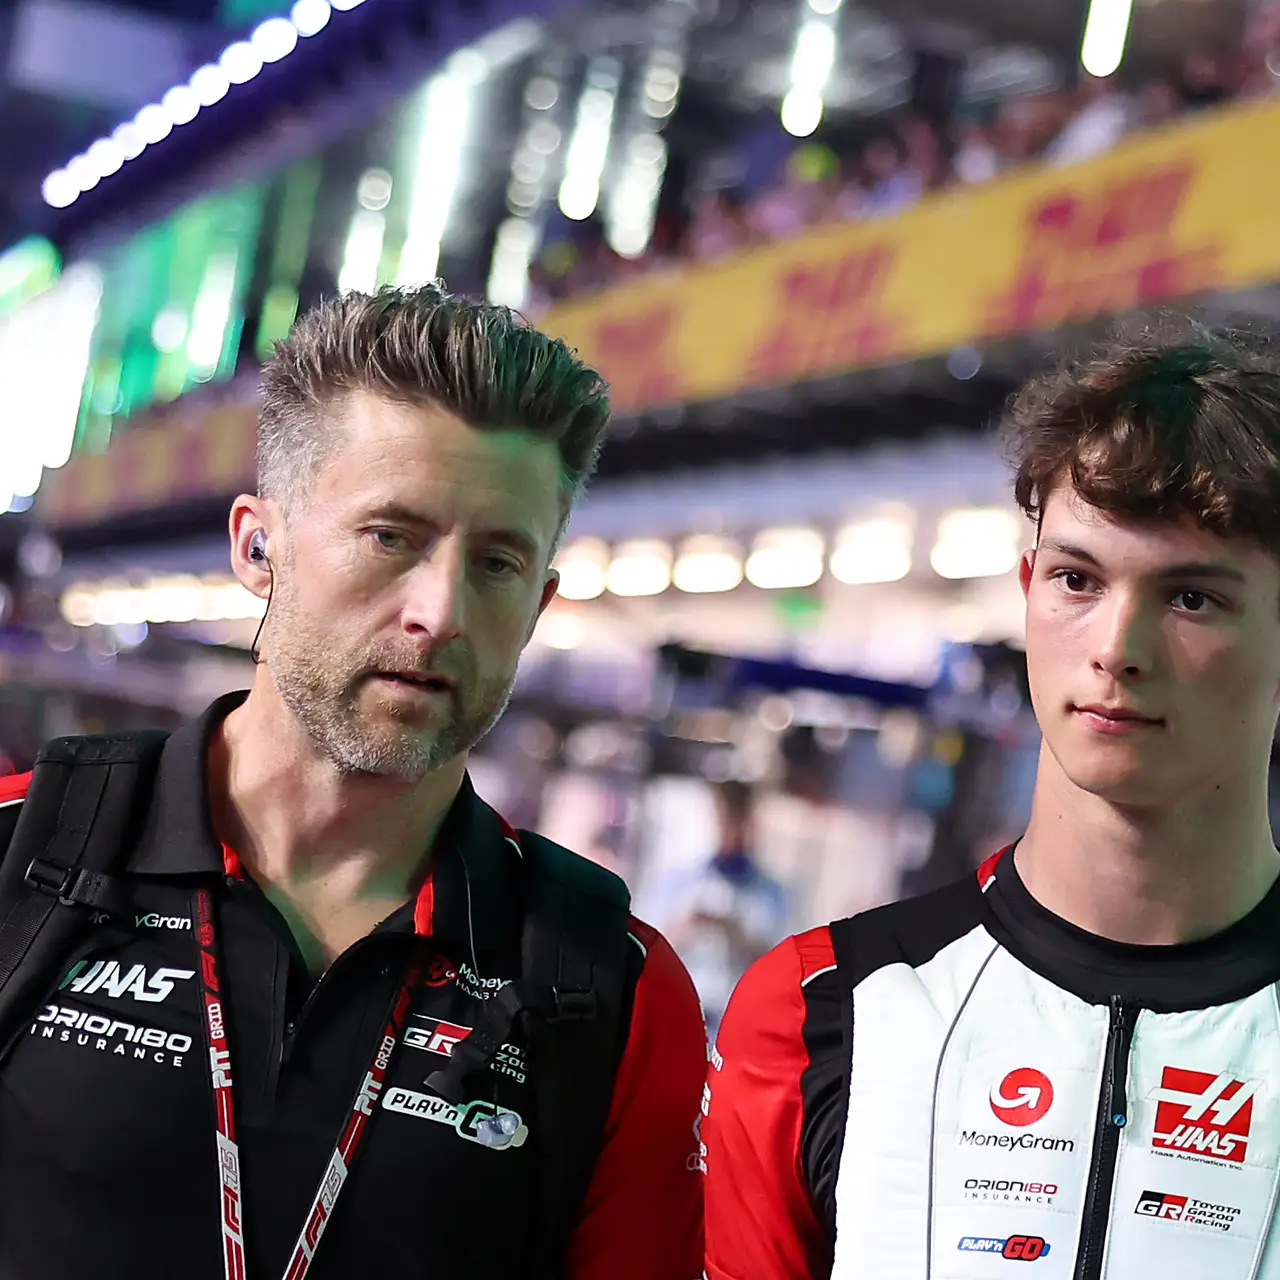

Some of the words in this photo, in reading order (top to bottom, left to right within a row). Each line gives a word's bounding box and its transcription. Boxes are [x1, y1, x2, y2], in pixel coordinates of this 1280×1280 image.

[58, 960, 196, 1003] HAAS
[207, 1003, 225, 1040] GRID
[30, 1023, 184, 1067] INSURANCE
[374, 1034, 396, 1070] GRID
[209, 1046, 233, 1090] PIT
[959, 1131, 1075, 1152] MoneyGram
[1153, 1123, 1249, 1156] HAAS
[1176, 1154, 1227, 1168] Automation
[964, 1193, 1053, 1205] INSURANCE
[1136, 1200, 1185, 1220] GR
[1190, 1199, 1242, 1215] TOYOTA
[1184, 1215, 1231, 1231] Racing
[1187, 1207, 1235, 1222] GAZOO
[1004, 1236, 1044, 1260] GO
